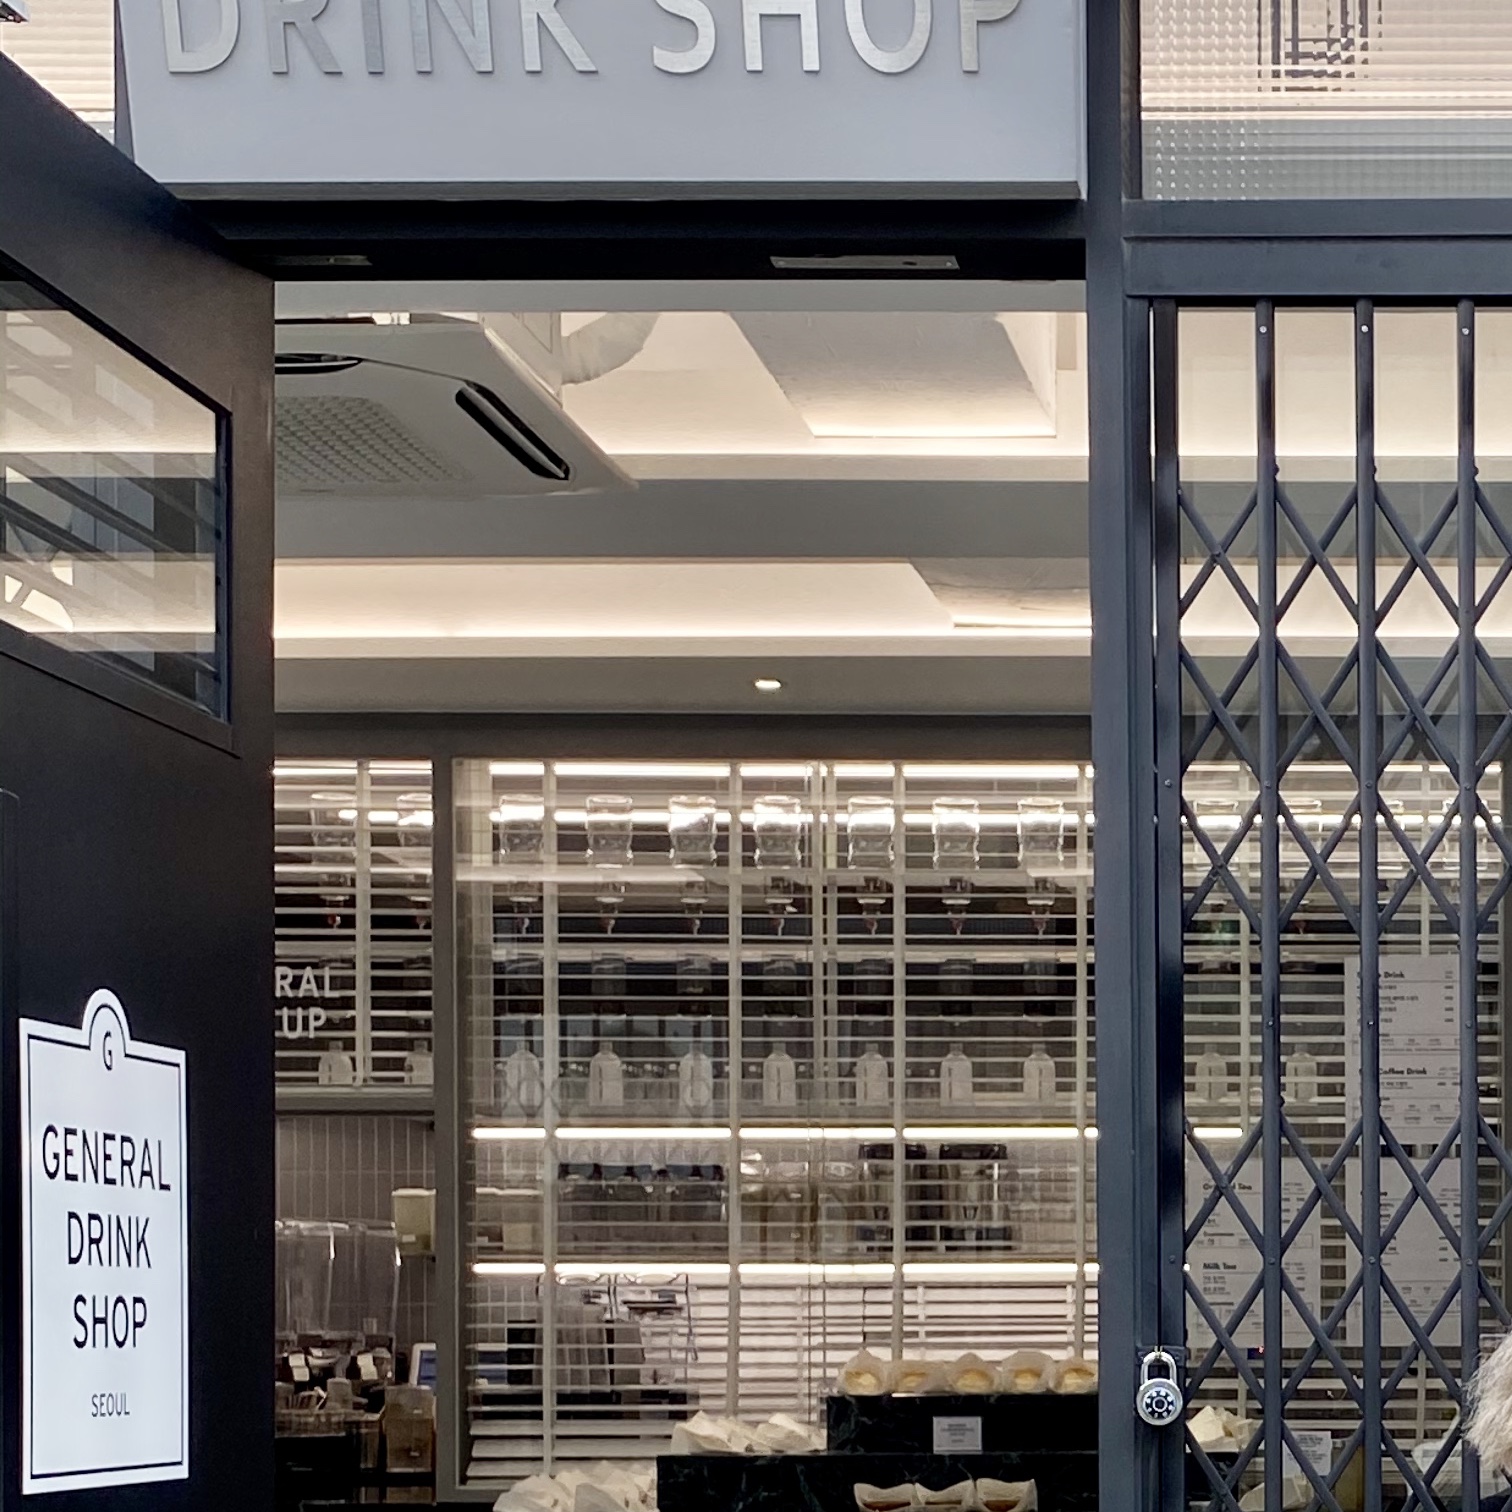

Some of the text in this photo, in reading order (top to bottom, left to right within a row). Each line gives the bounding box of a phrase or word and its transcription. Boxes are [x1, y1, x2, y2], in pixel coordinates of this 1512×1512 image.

[275, 965, 340, 998] RAL
[281, 1006, 327, 1039] UP
[102, 1030, 114, 1071] G
[42, 1124, 172, 1192] GENERAL
[67, 1211, 152, 1269] DRINK
[73, 1294, 148, 1349] SHOP
[91, 1392, 131, 1418] SEOUL
